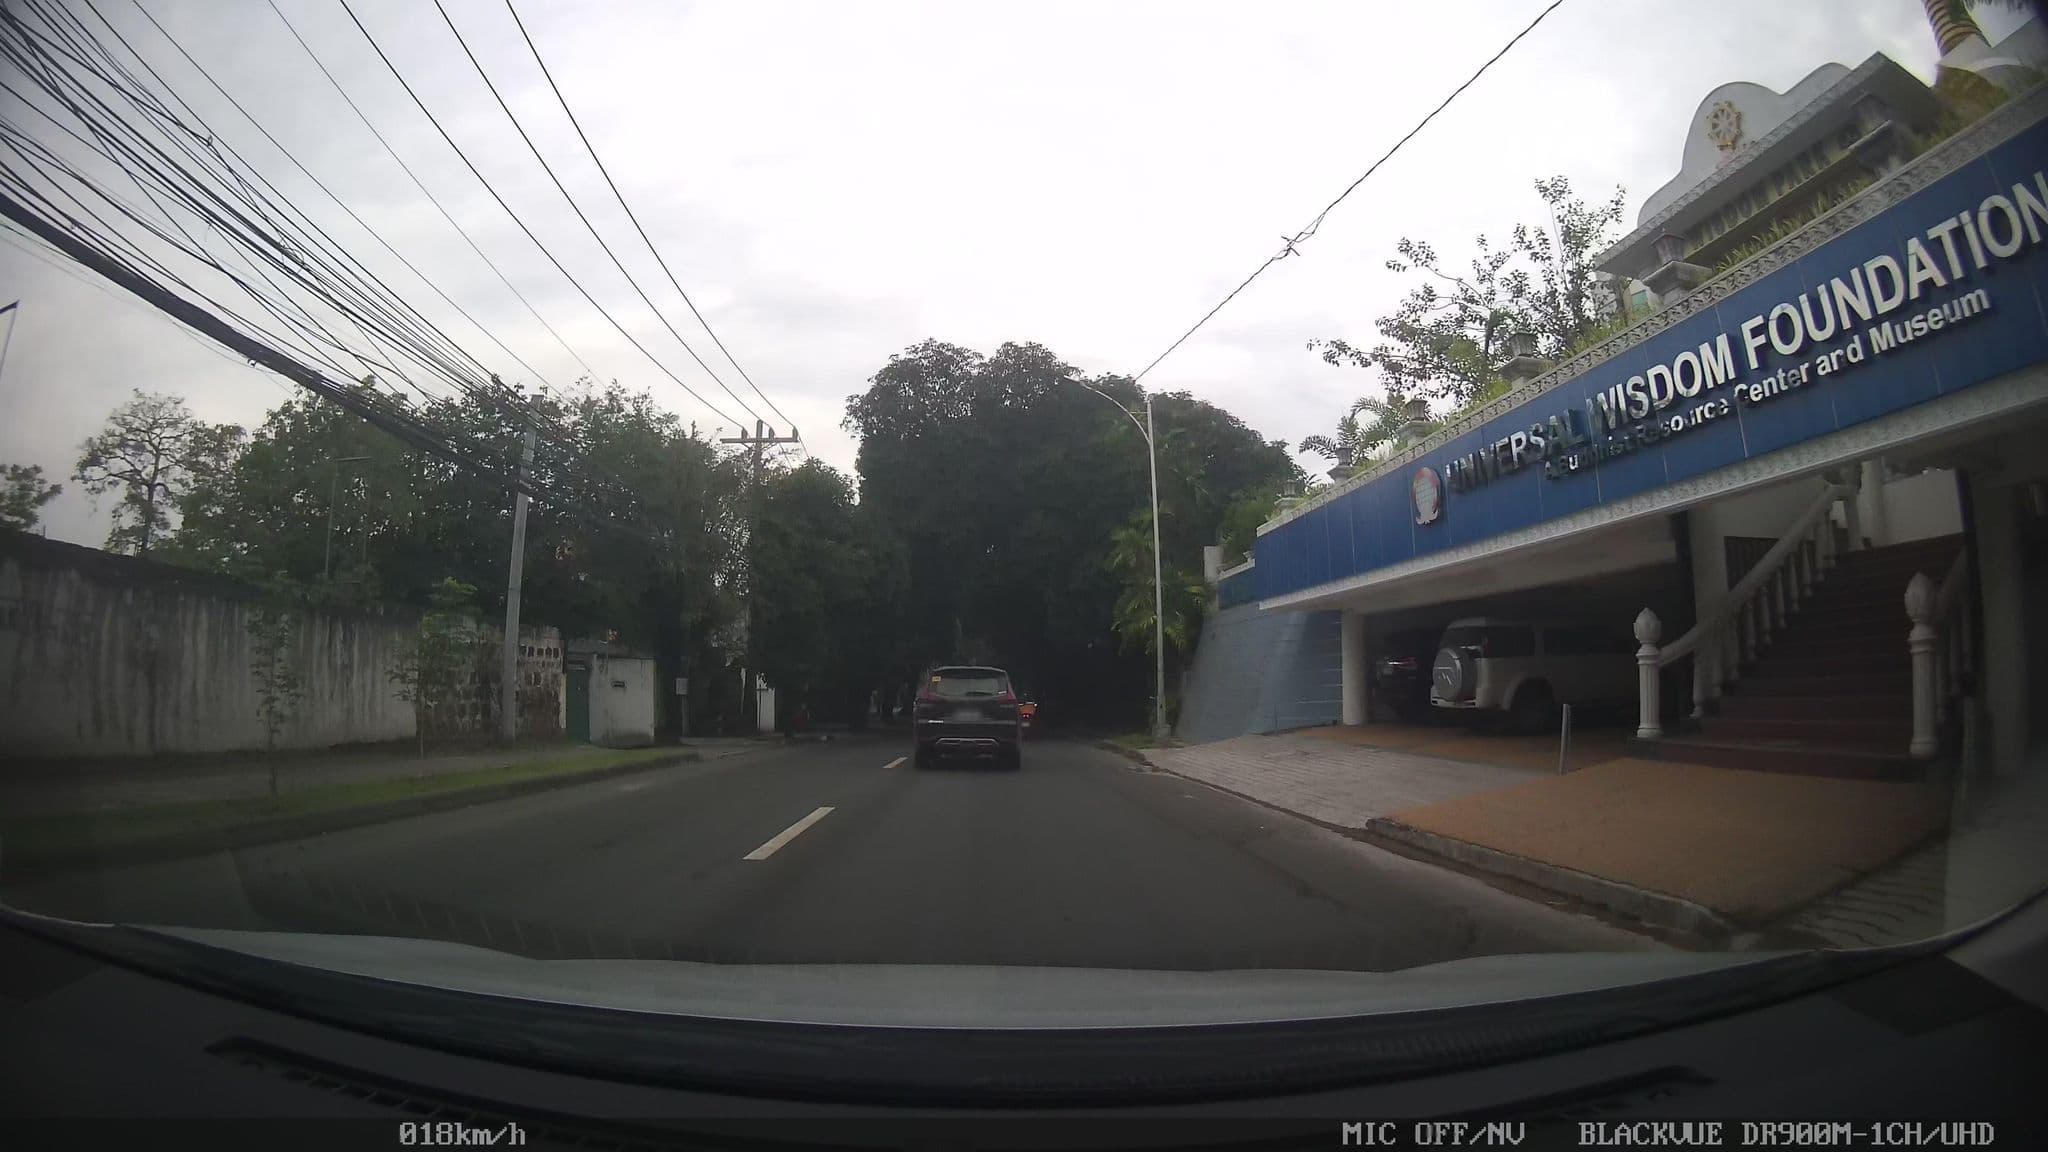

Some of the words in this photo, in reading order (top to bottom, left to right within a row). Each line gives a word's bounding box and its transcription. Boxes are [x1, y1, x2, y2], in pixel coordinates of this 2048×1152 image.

[1445, 408, 1584, 491] UNIVERSAL
[1586, 333, 1736, 430] WISDOM
[1741, 171, 2048, 370] FOUNDATION
[1734, 361, 1809, 404] Center
[1869, 288, 1990, 354] Museum
